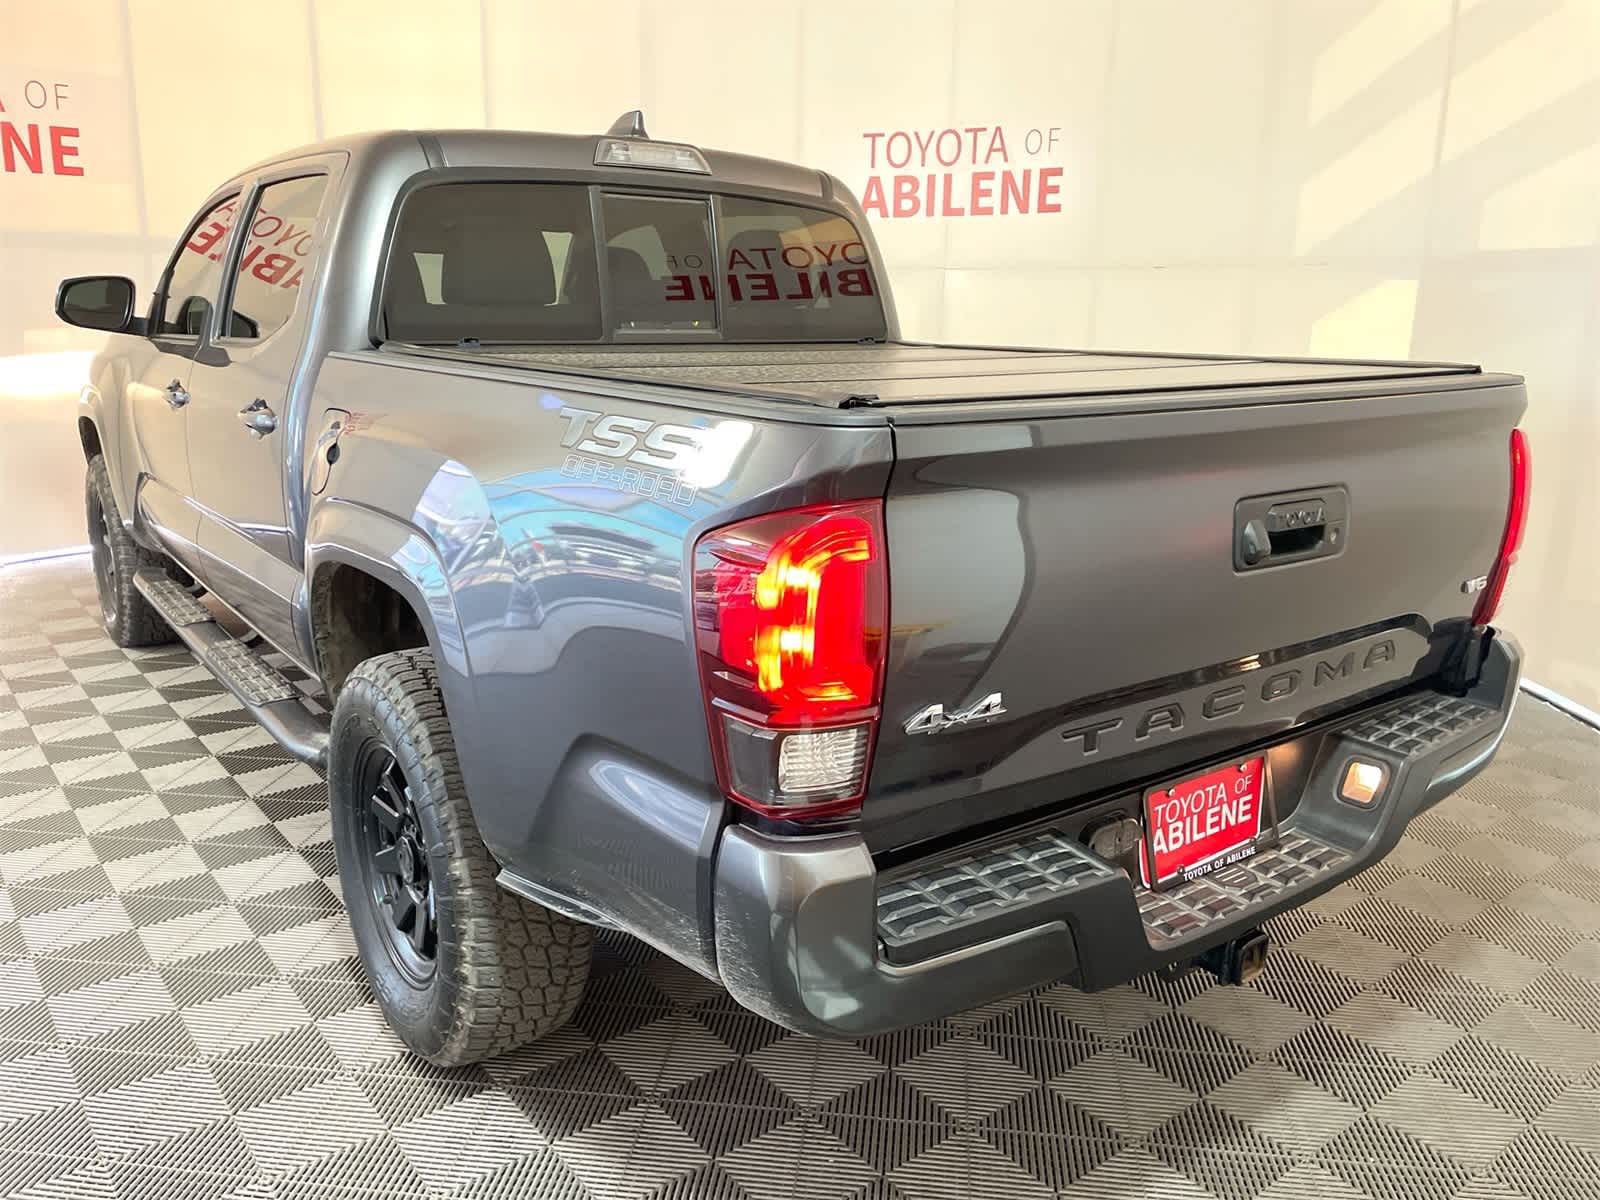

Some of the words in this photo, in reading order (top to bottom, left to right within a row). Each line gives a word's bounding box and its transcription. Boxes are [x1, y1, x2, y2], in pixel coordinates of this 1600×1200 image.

[24, 80, 69, 111] OF
[863, 126, 1008, 169] TOYOTA
[1024, 127, 1061, 156] OF
[861, 167, 1064, 218] ABILENE
[559, 407, 709, 471] TSS
[559, 454, 701, 508] OFF-ROAD
[1278, 507, 1326, 528] TOYOTA
[1061, 640, 1398, 757] TACOMA
[1153, 794, 1254, 857] ABILENE
[1154, 782, 1228, 828] TOYOTA
[1234, 775, 1253, 795] OF
[1183, 864, 1213, 881] TOYOTA
[1214, 858, 1225, 869] OF
[1226, 846, 1257, 866] ABILENE
